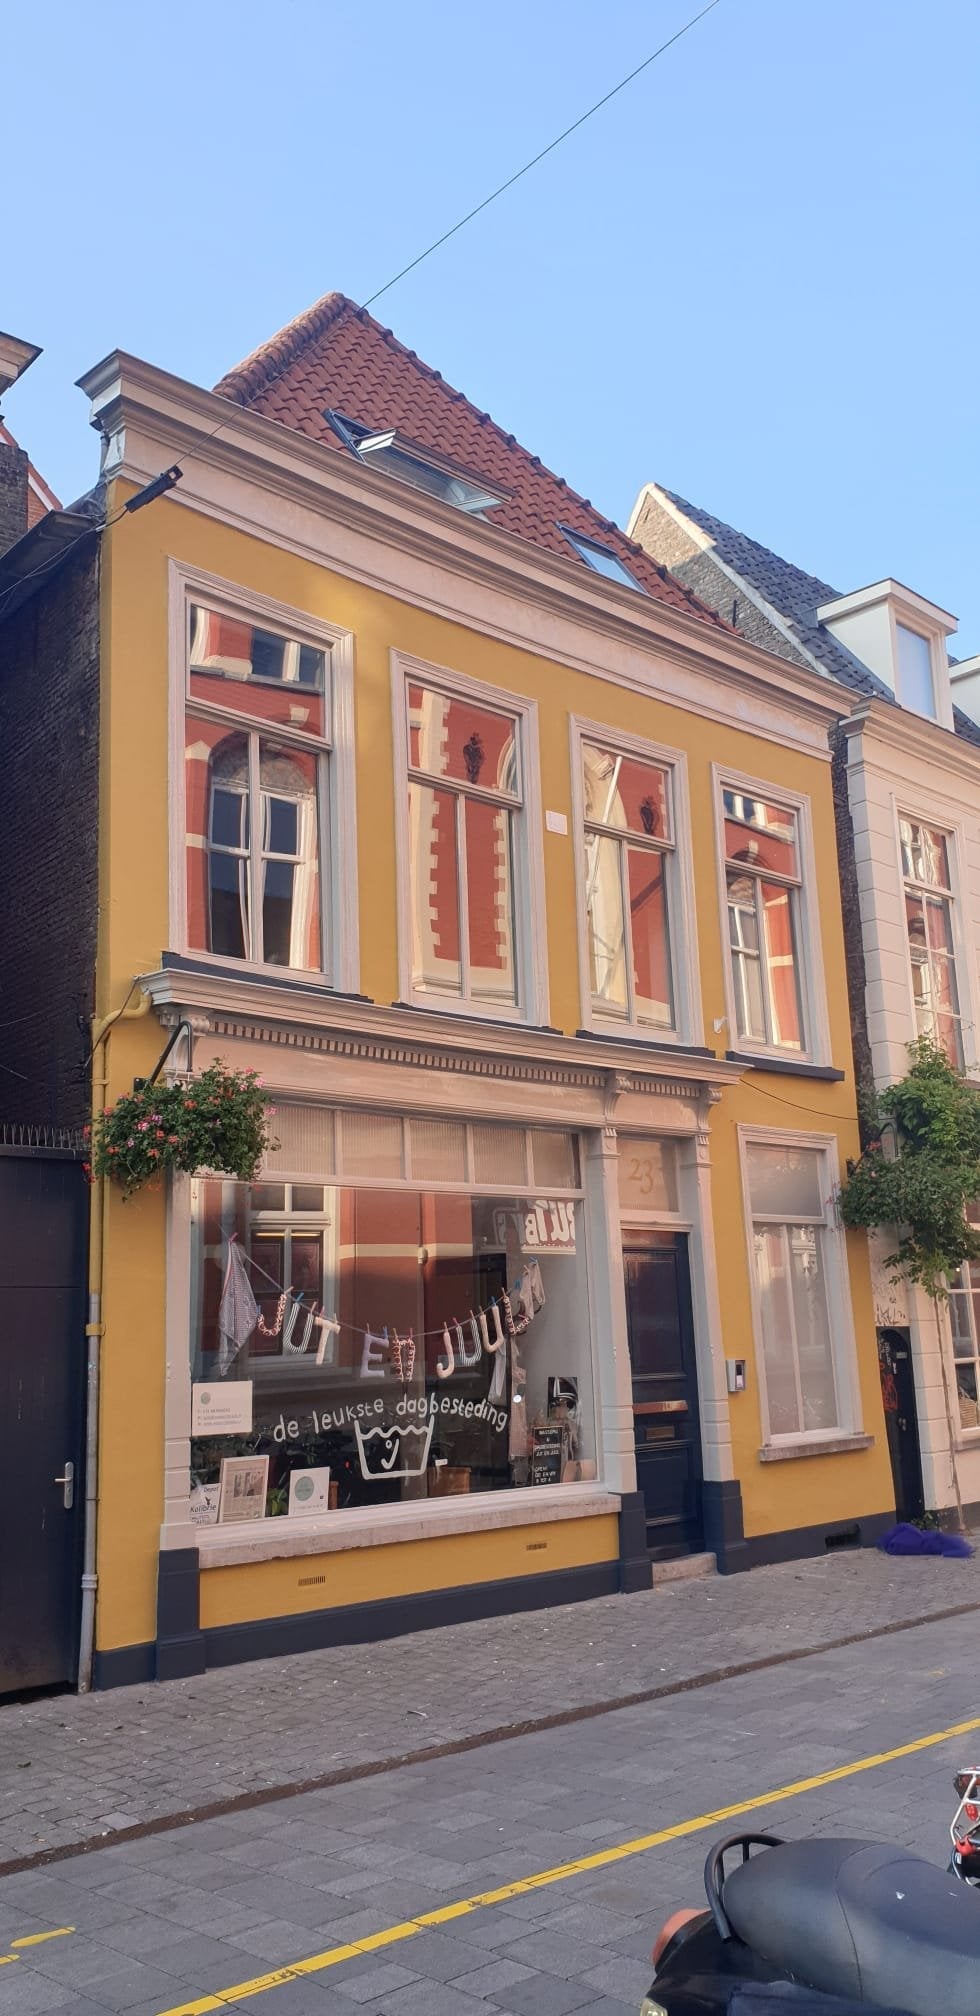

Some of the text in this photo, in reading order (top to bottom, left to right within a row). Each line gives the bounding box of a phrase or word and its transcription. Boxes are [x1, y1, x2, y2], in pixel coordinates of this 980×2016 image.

[628, 1158, 654, 1194] 23
[256, 1293, 342, 1366] JUT
[436, 1294, 533, 1380] JUUL
[273, 1392, 508, 1443] de leukste dagbesteding
